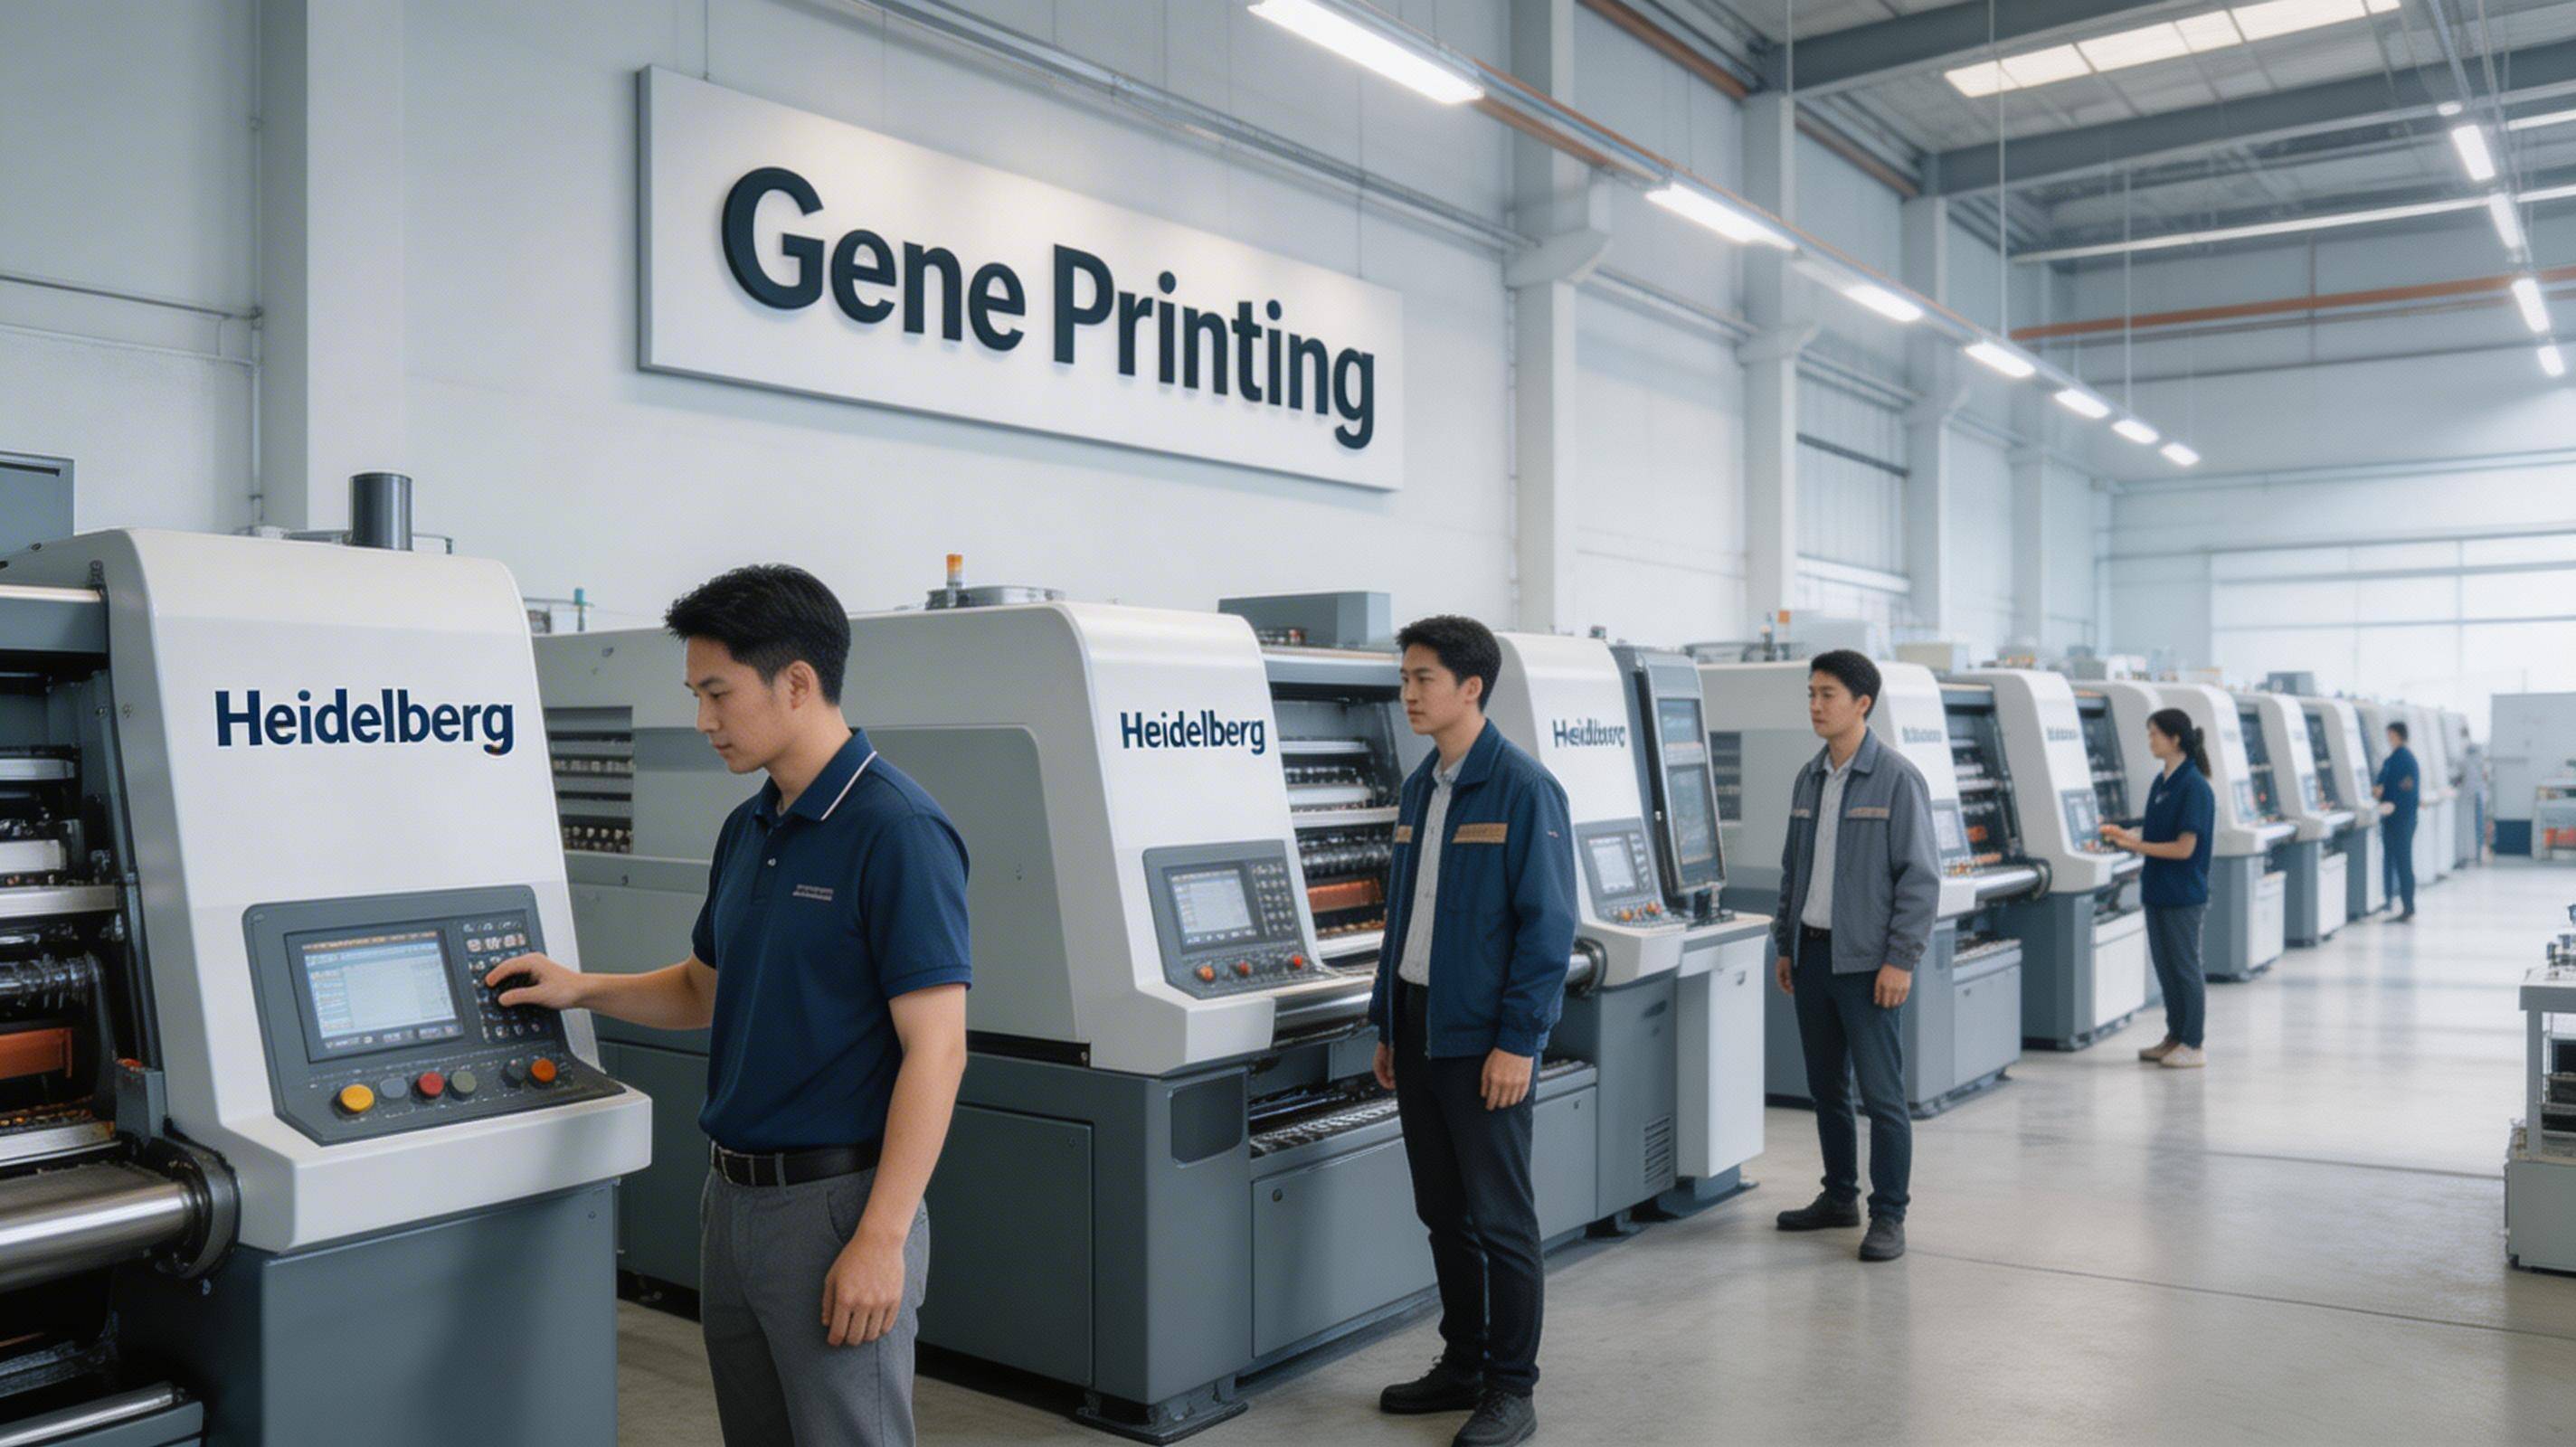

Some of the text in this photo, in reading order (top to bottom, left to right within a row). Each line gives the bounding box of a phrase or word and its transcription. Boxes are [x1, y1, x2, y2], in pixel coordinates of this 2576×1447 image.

[719, 166, 1375, 450] Gene Printing
[213, 687, 515, 757] Heidelberg
[1120, 709, 1266, 755] Heidelberg
